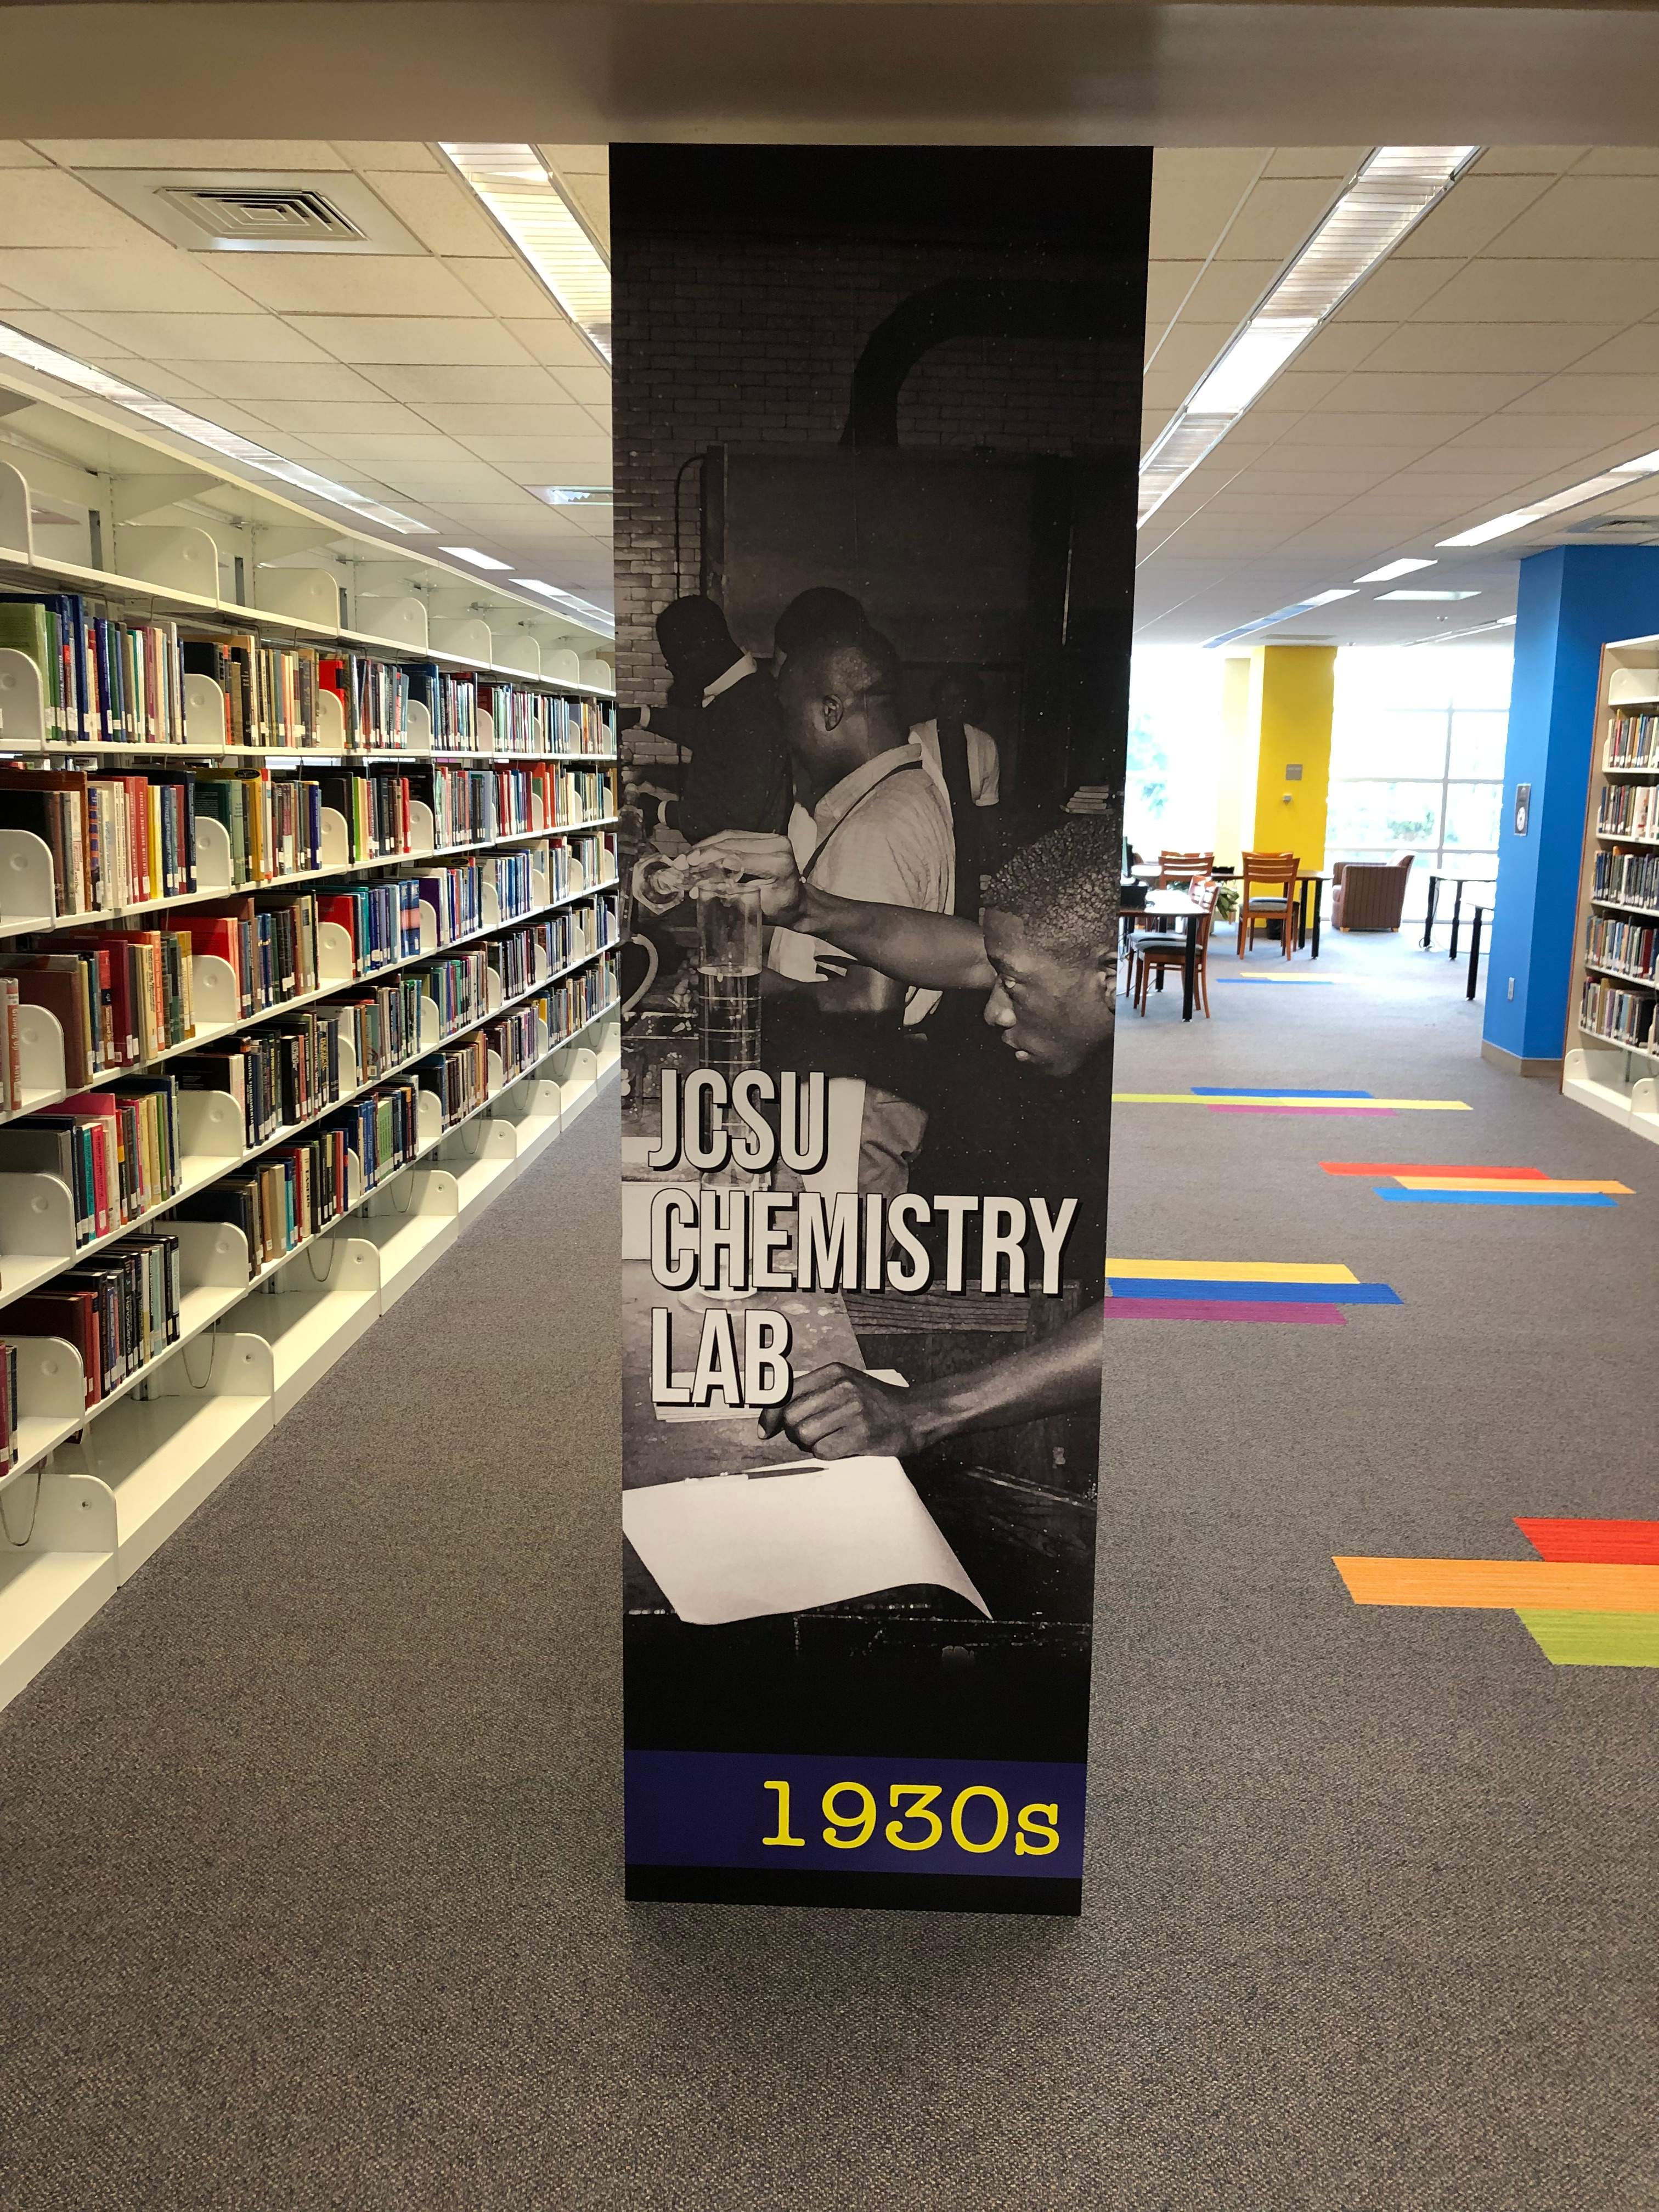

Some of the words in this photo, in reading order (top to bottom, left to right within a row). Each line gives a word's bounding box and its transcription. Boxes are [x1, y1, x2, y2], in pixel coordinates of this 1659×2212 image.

[12, 1041, 19, 1051] Up
[648, 1068, 830, 1173] JCSU
[650, 1188, 1083, 1297] CHEMISTRY
[651, 1307, 794, 1408] LAB
[762, 1780, 1059, 1855] 1930s
